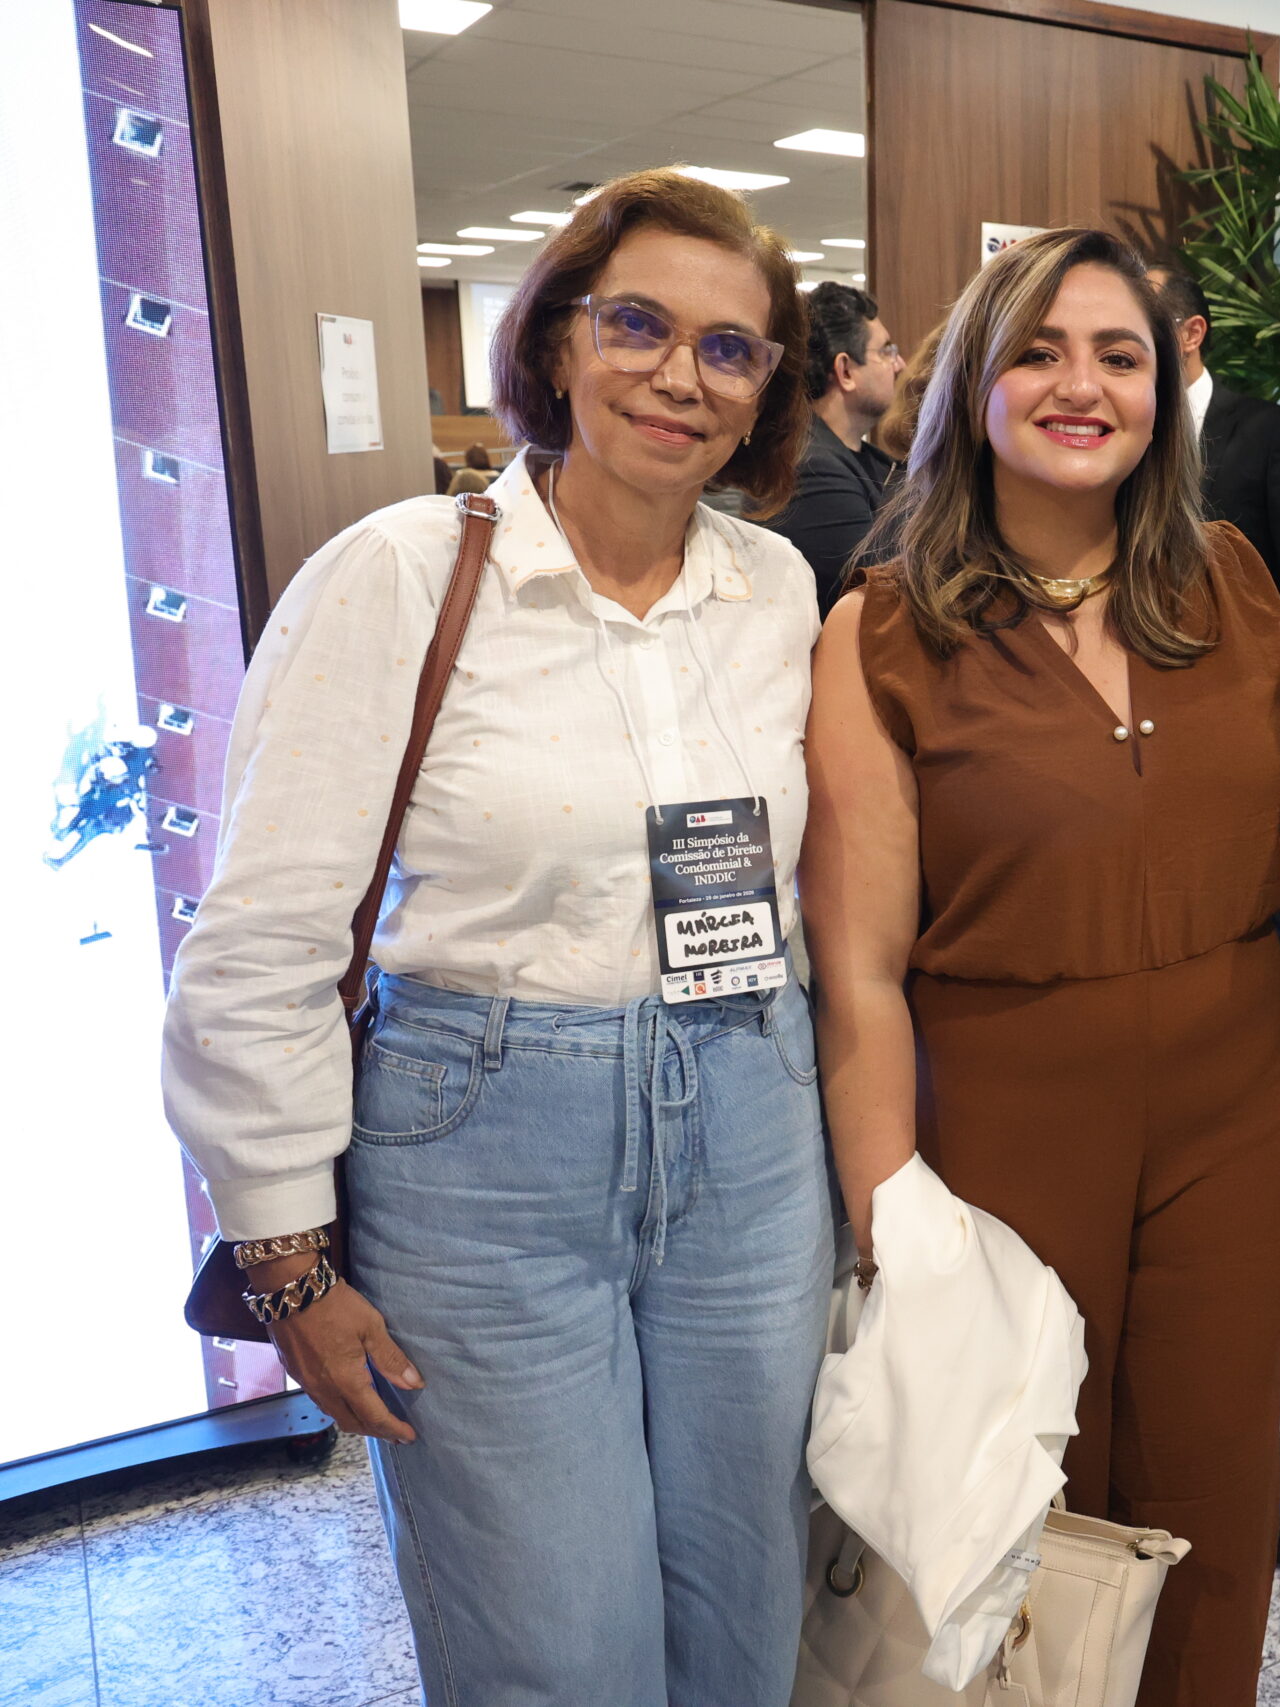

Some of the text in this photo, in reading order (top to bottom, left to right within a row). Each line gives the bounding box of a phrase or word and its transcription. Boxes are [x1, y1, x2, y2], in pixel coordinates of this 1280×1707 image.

[672, 832, 750, 850] III Simpósio da
[659, 843, 763, 864] Comissão de Direito
[675, 856, 753, 875] Condominial &
[694, 871, 737, 886] INDDIC
[683, 932, 763, 958] MOREIRA
[666, 974, 688, 983] Cimel
